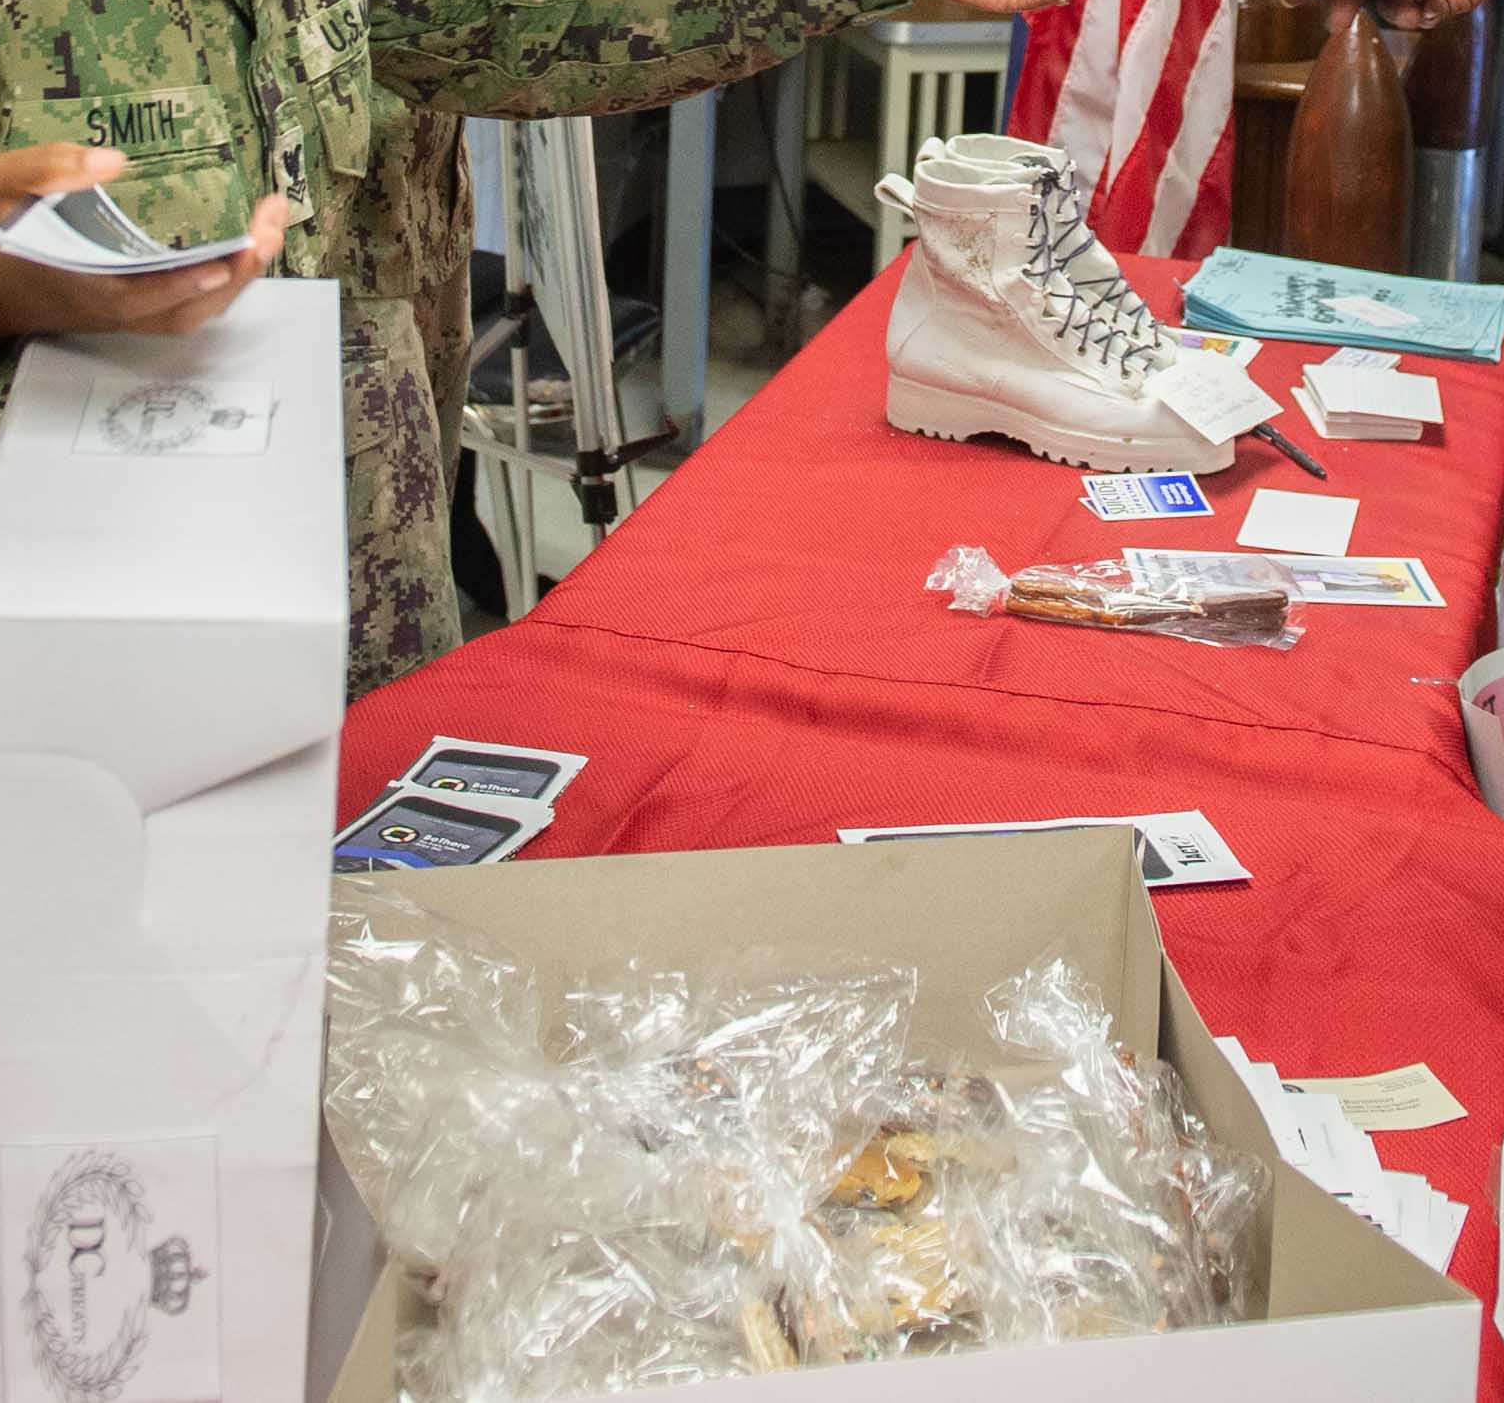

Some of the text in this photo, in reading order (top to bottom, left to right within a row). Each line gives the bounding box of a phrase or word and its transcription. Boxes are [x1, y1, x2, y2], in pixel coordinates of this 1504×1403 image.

[87, 100, 176, 147] SMITH
[1096, 479, 1128, 514] SUICIDE
[471, 781, 521, 794] BeThere
[423, 833, 471, 850] BeThere
